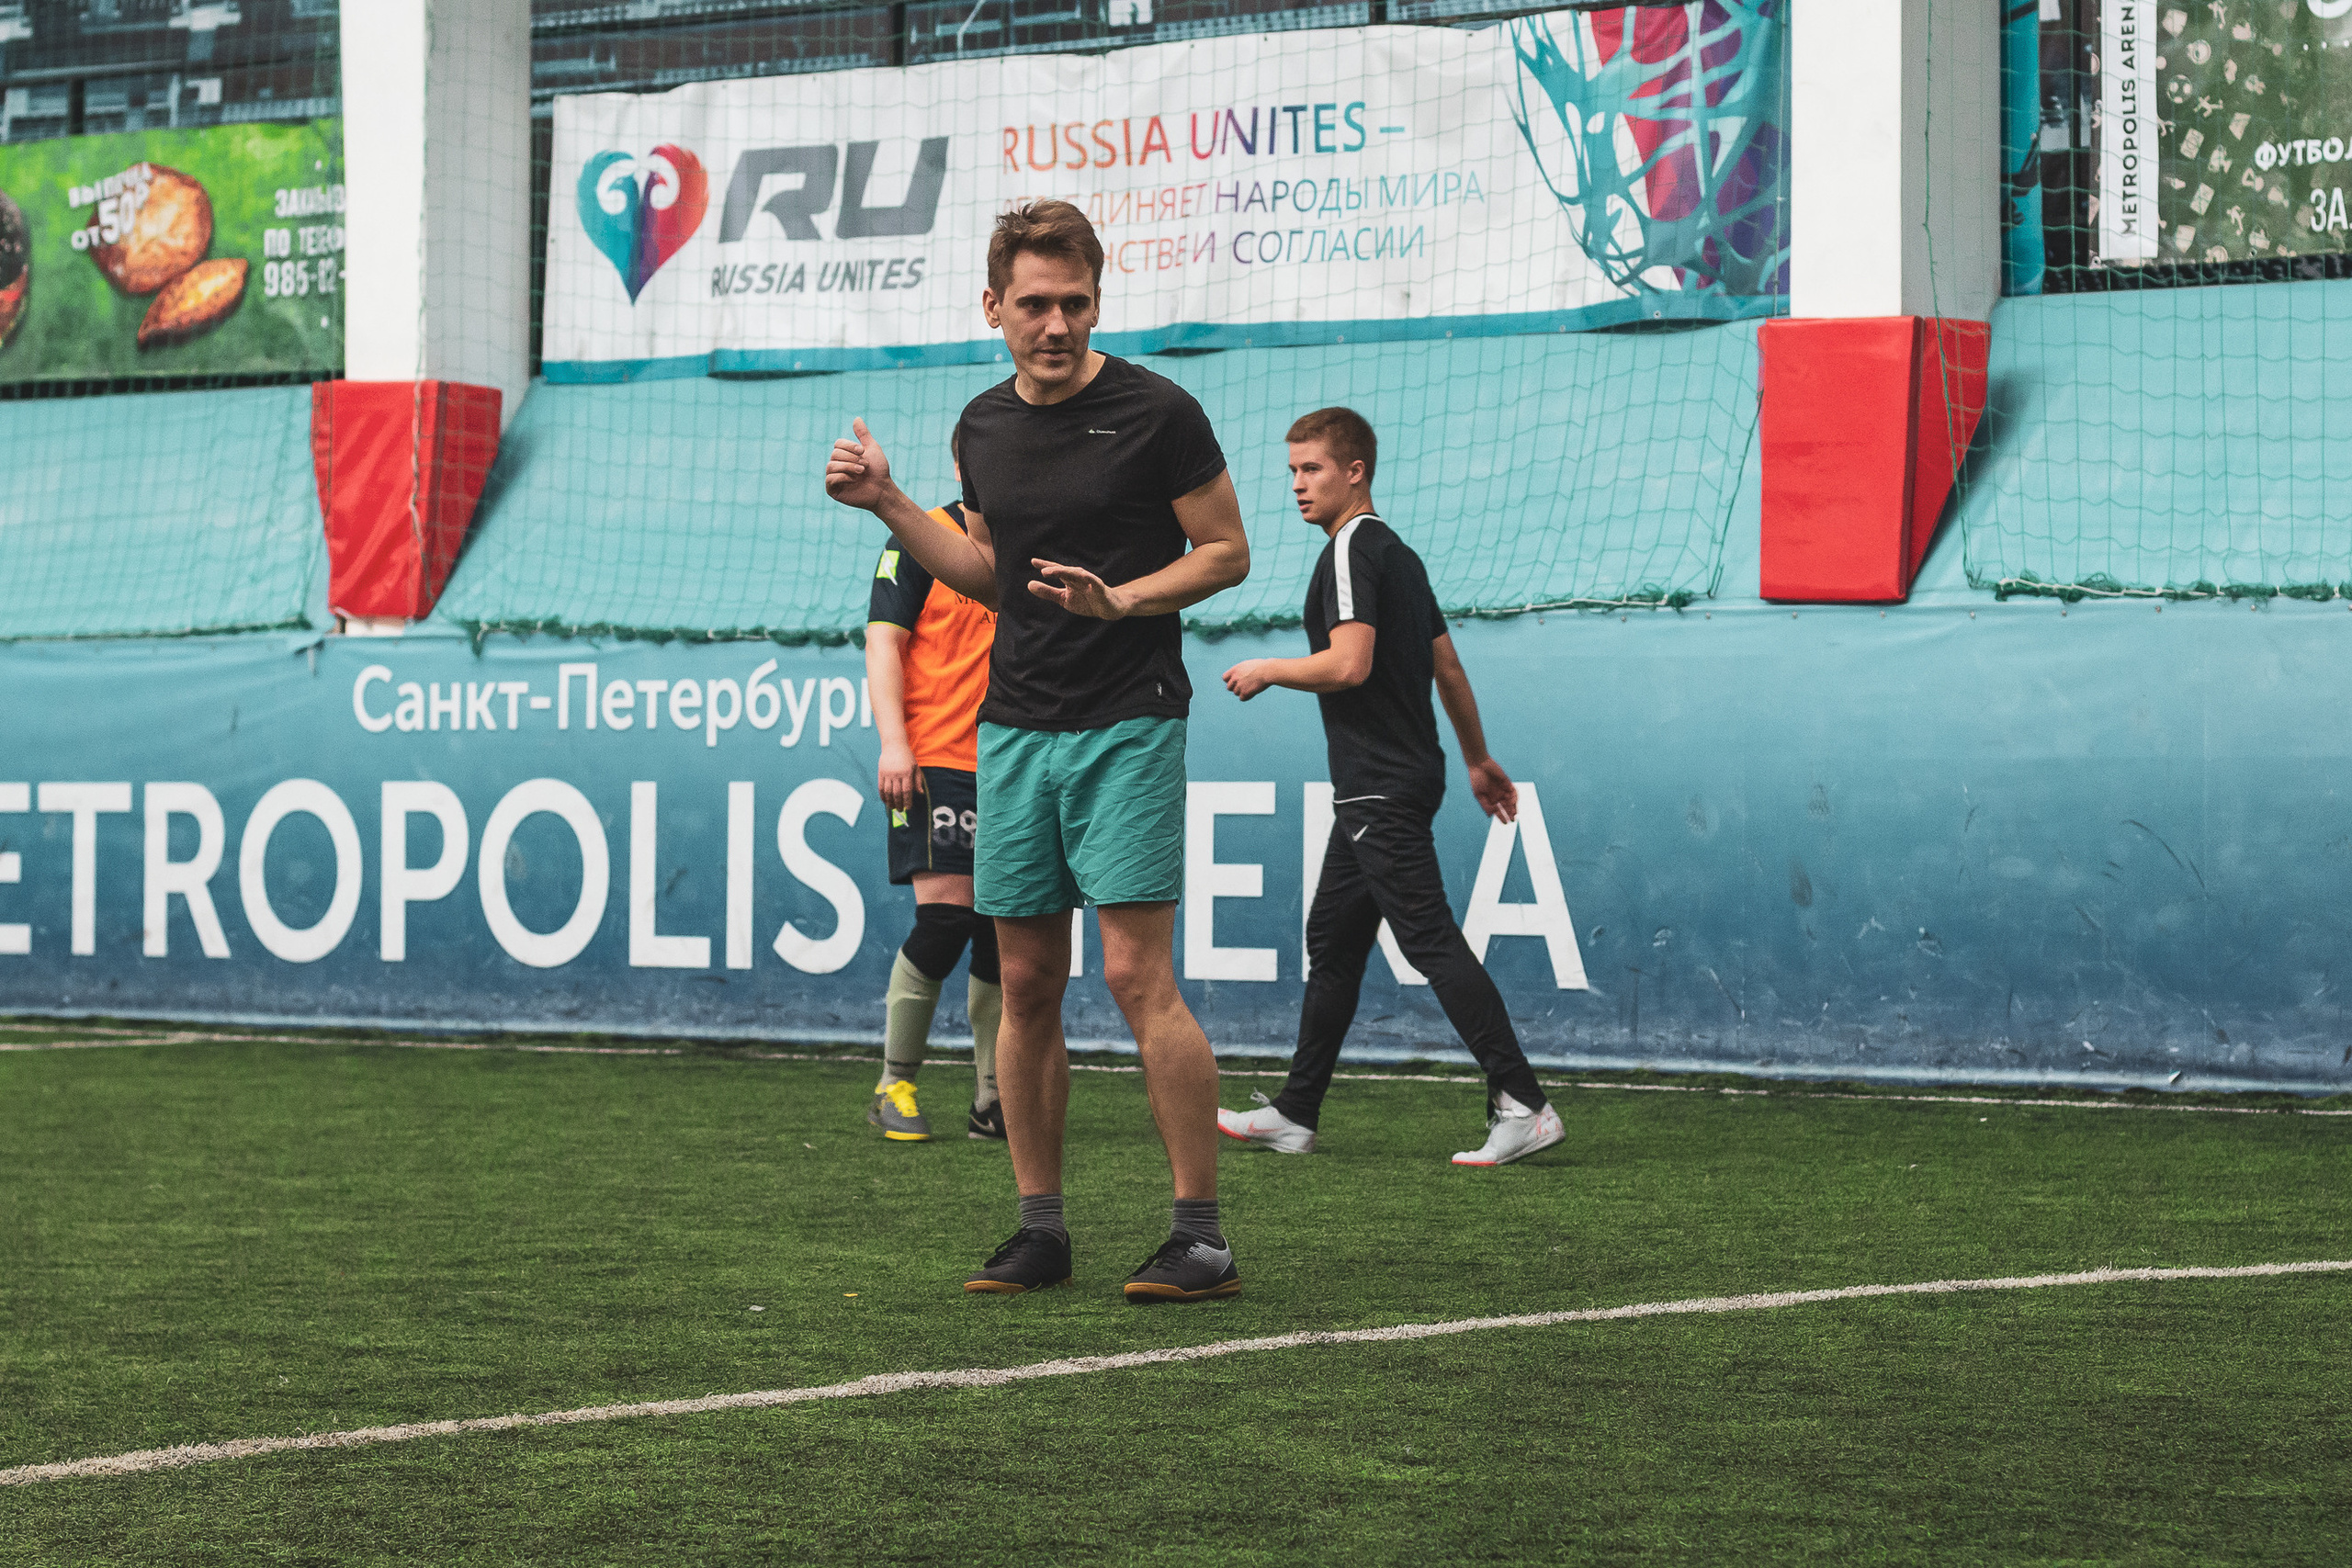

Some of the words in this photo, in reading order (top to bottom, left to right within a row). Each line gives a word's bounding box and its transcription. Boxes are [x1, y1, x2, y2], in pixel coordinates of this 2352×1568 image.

[2120, 0, 2136, 71] AREN
[1002, 114, 1173, 175] RUSSIA
[1189, 100, 1368, 161] UNITES
[2120, 78, 2138, 238] METROPOLIS
[718, 136, 950, 244] RU
[1215, 175, 1369, 220] НАРОДЫ
[1379, 170, 1486, 208] МИРА
[2309, 186, 2352, 232] ЗА
[1192, 231, 1216, 264] И
[1232, 224, 1425, 265] СОГЛАСИИ
[711, 260, 806, 299] RUSSIA
[817, 255, 926, 293] UNITES
